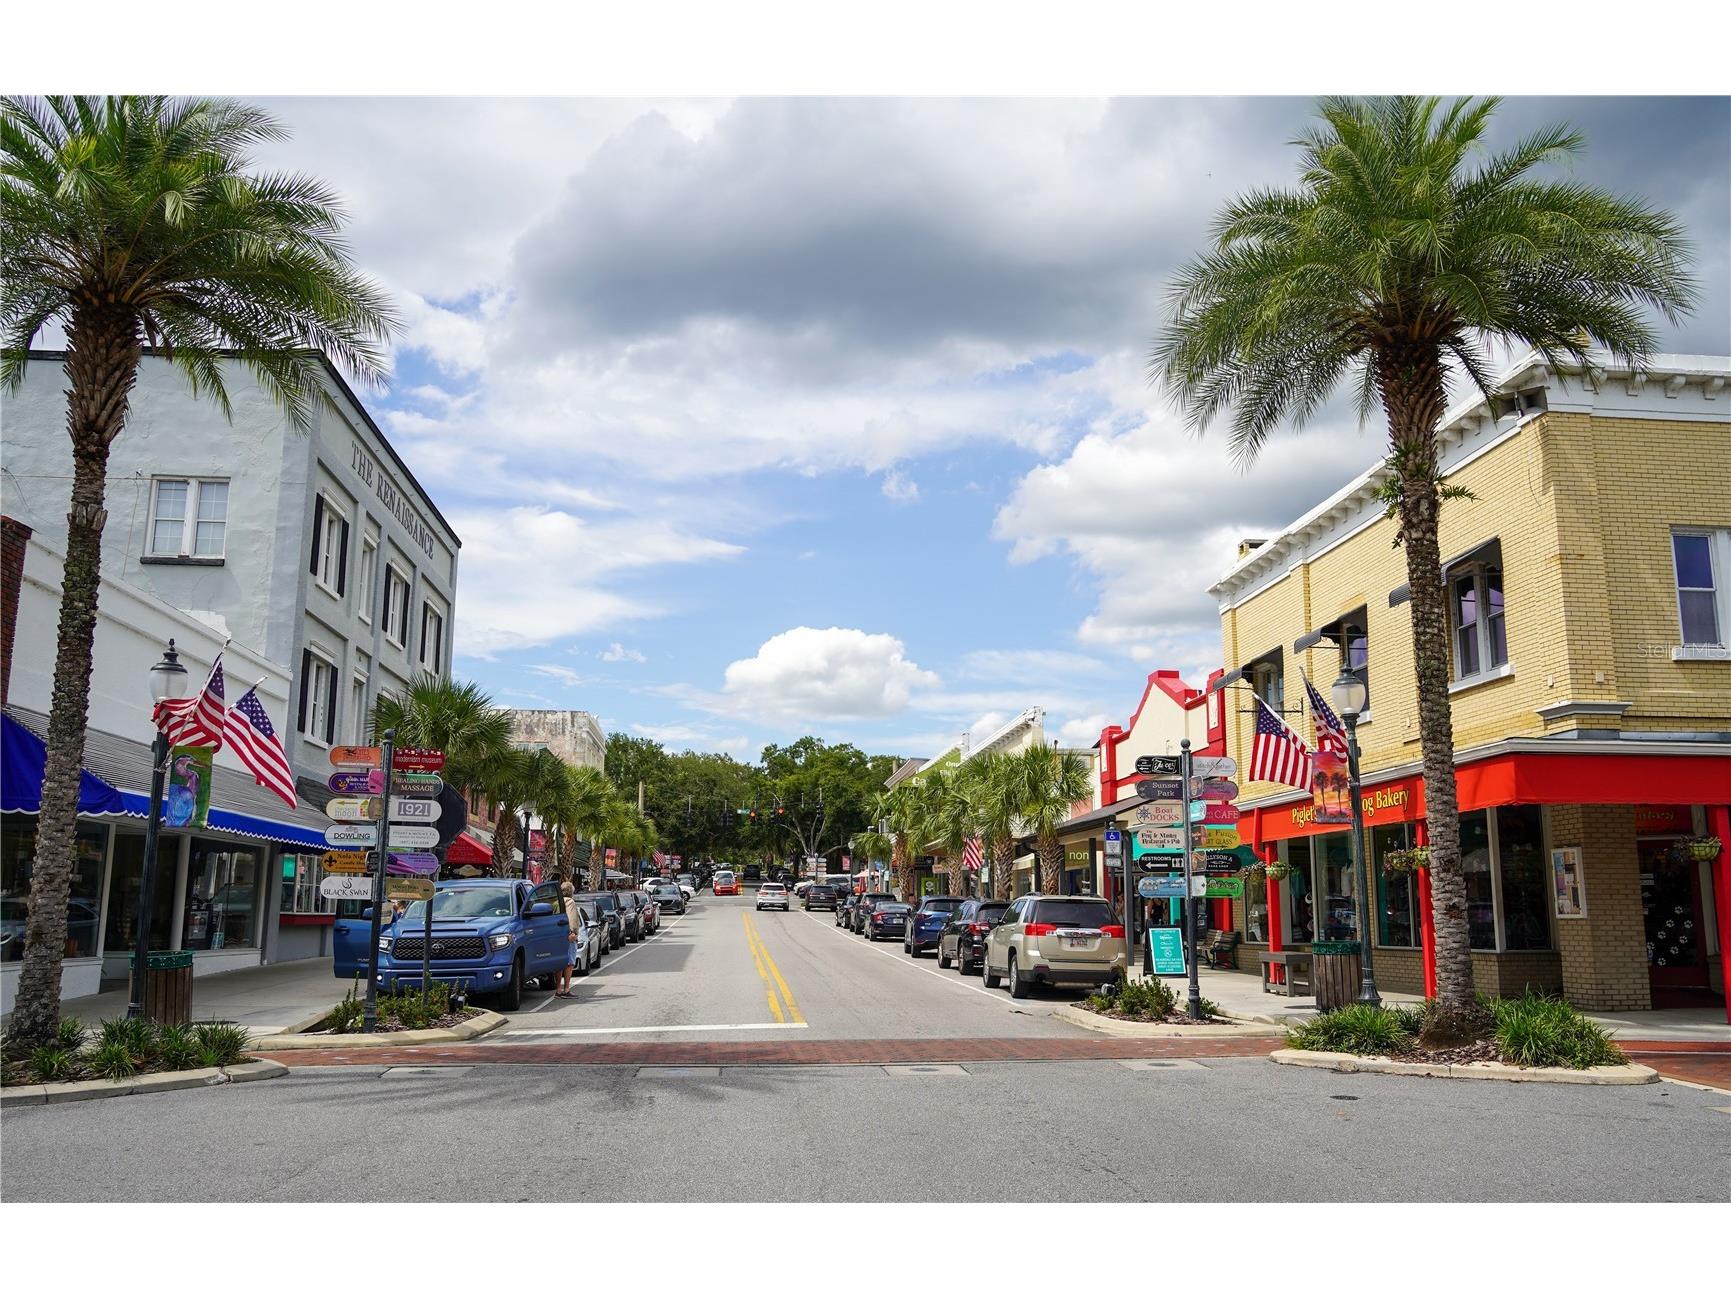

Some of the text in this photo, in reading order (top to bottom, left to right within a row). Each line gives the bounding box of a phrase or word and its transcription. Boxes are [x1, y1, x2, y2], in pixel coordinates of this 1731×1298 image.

[352, 440, 434, 559] THE RENAISSANCE
[400, 784, 434, 792] MASSAGE
[1362, 797, 1375, 817] og
[1375, 787, 1409, 811] Bakery
[399, 803, 431, 816] 1921
[1150, 813, 1180, 821] DOCKS
[1214, 810, 1239, 819] CAFE
[333, 832, 371, 840] DOWLING
[323, 888, 369, 897] BLACK SWAN
